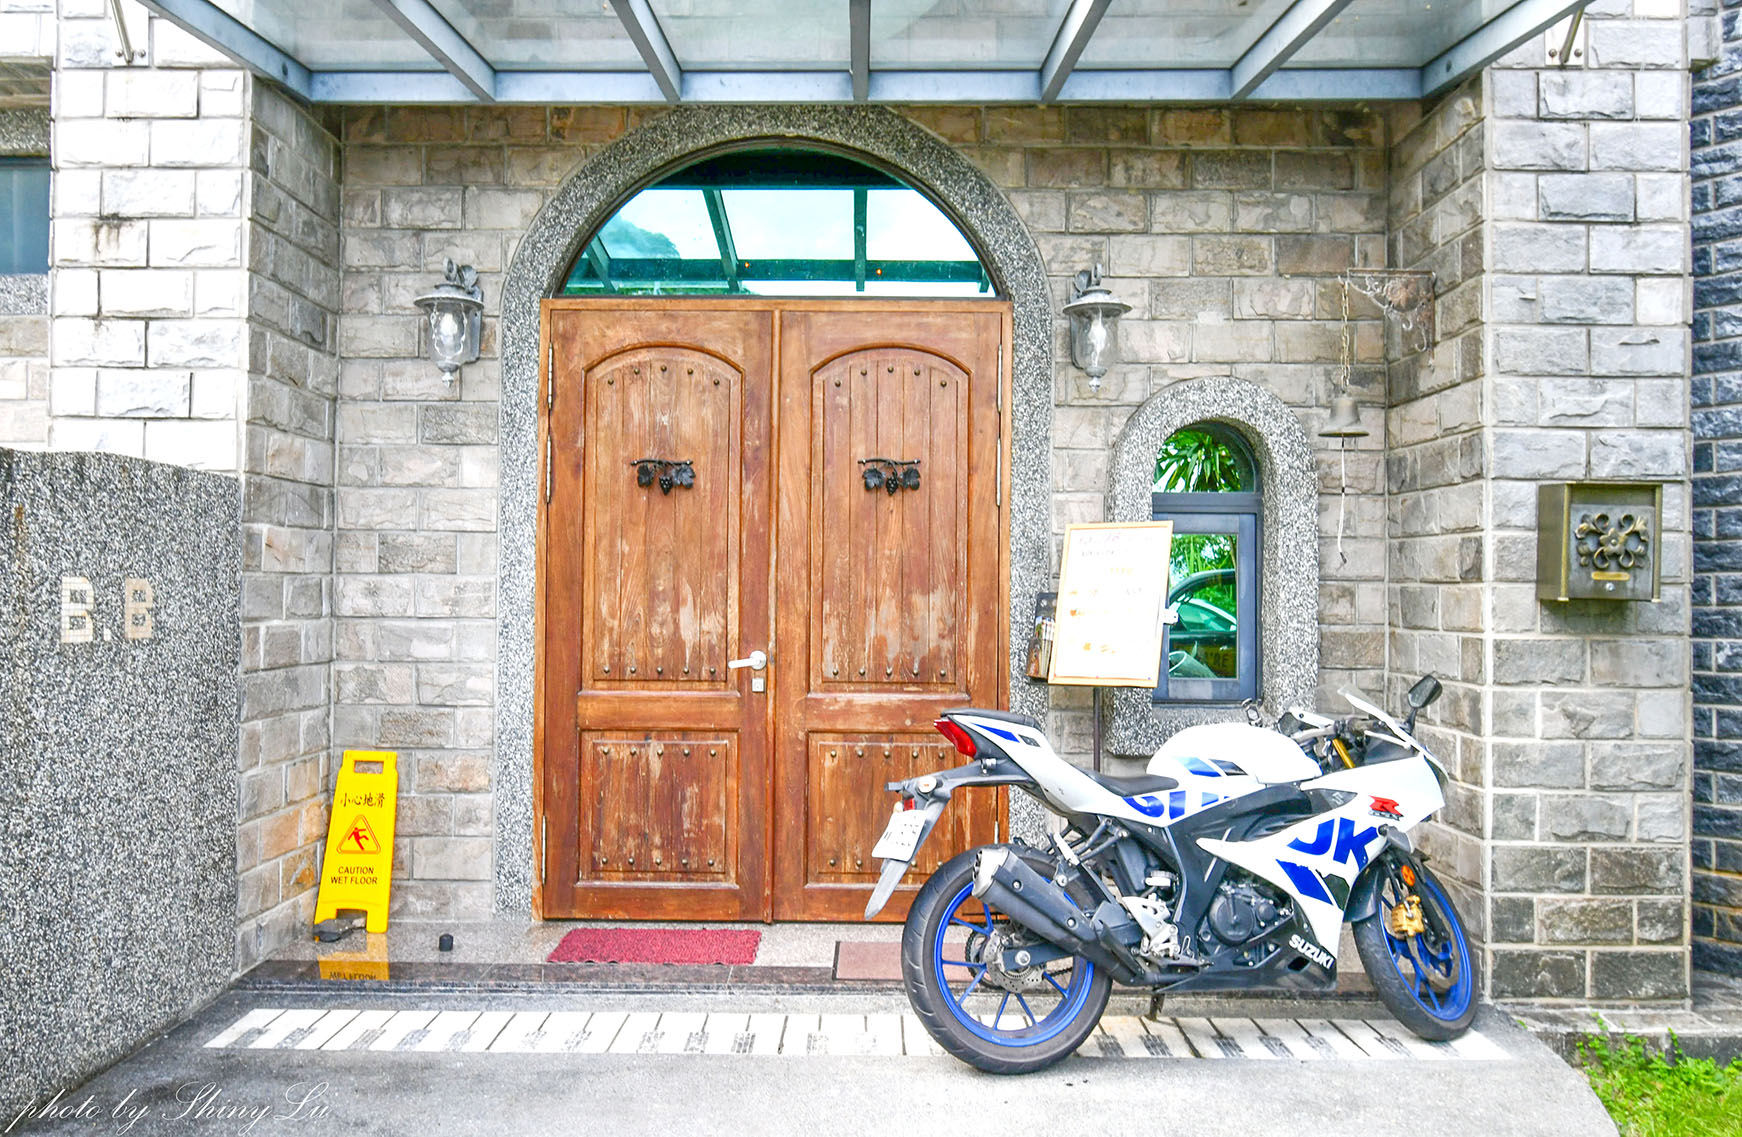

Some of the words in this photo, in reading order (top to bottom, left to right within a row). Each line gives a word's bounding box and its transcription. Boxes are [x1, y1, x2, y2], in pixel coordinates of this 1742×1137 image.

[340, 792, 386, 809] 小心地滑
[338, 866, 375, 875] CAUTION
[330, 876, 348, 885] WET
[350, 876, 378, 885] FLOOR
[1288, 934, 1335, 970] SUZUKI
